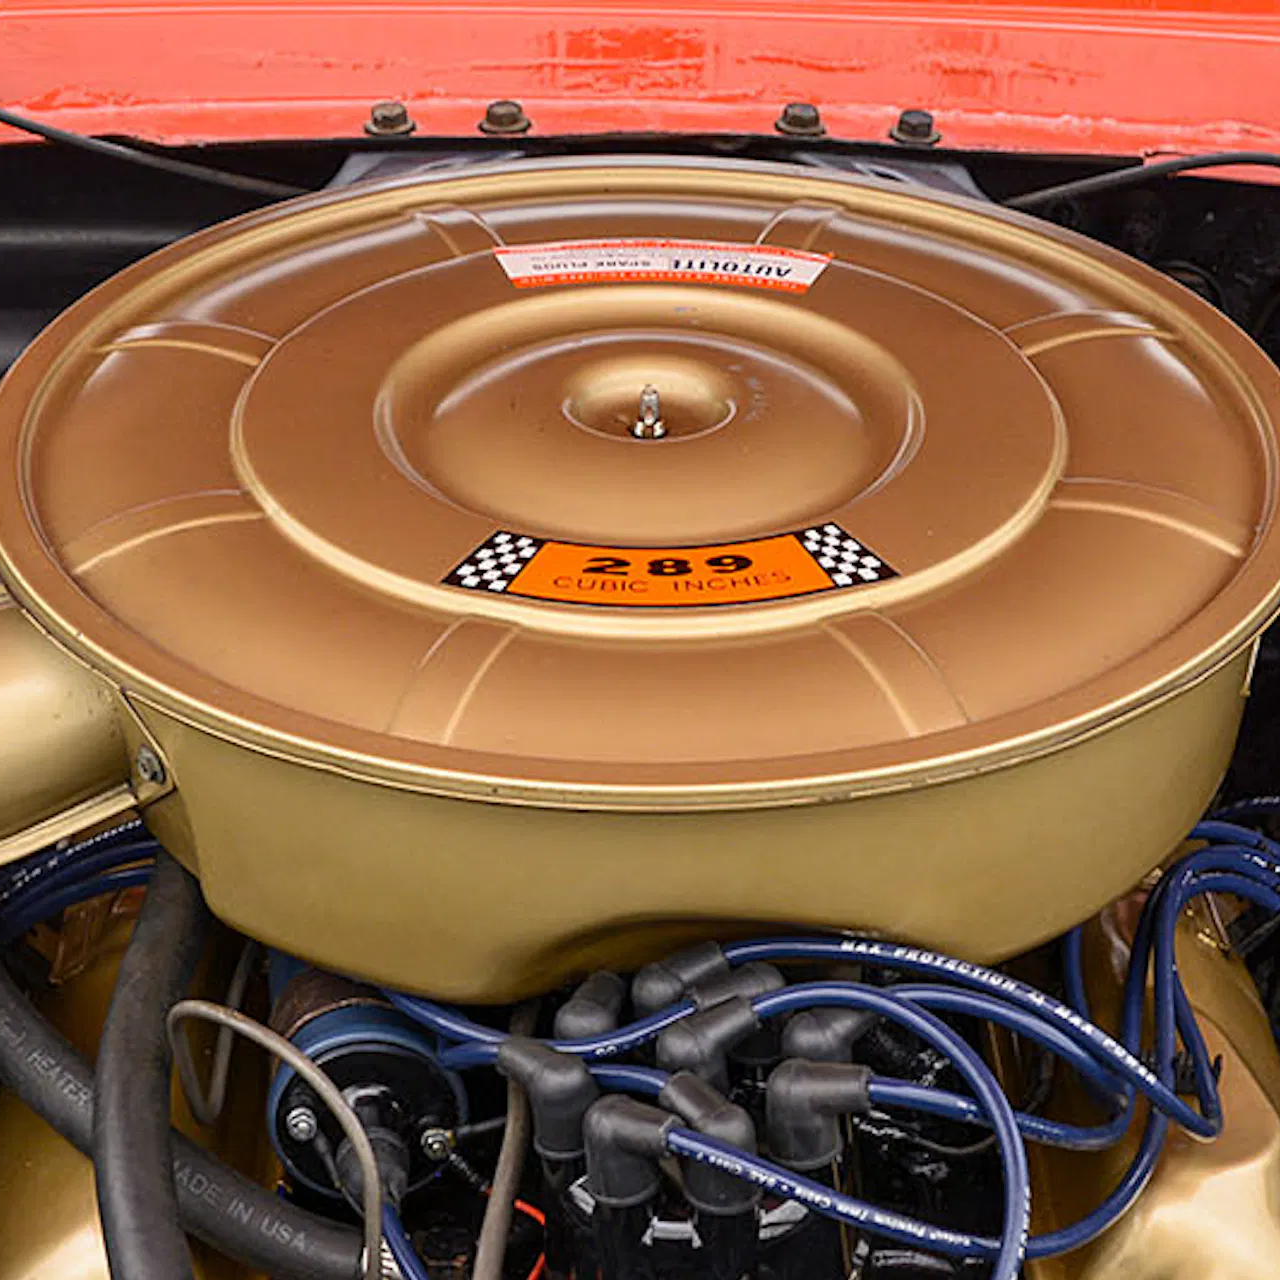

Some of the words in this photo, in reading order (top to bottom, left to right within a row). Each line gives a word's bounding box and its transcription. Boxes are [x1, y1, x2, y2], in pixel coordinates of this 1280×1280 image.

[552, 575, 649, 594] CUBIC
[673, 571, 792, 592] INCHES
[581, 553, 753, 577] 289
[841, 940, 881, 954] MAX
[1102, 1037, 1158, 1086] POWER
[27, 1050, 92, 1107] HEATER
[173, 1160, 220, 1206] ADE
[227, 1198, 255, 1224] IN
[260, 1217, 307, 1251] USA
